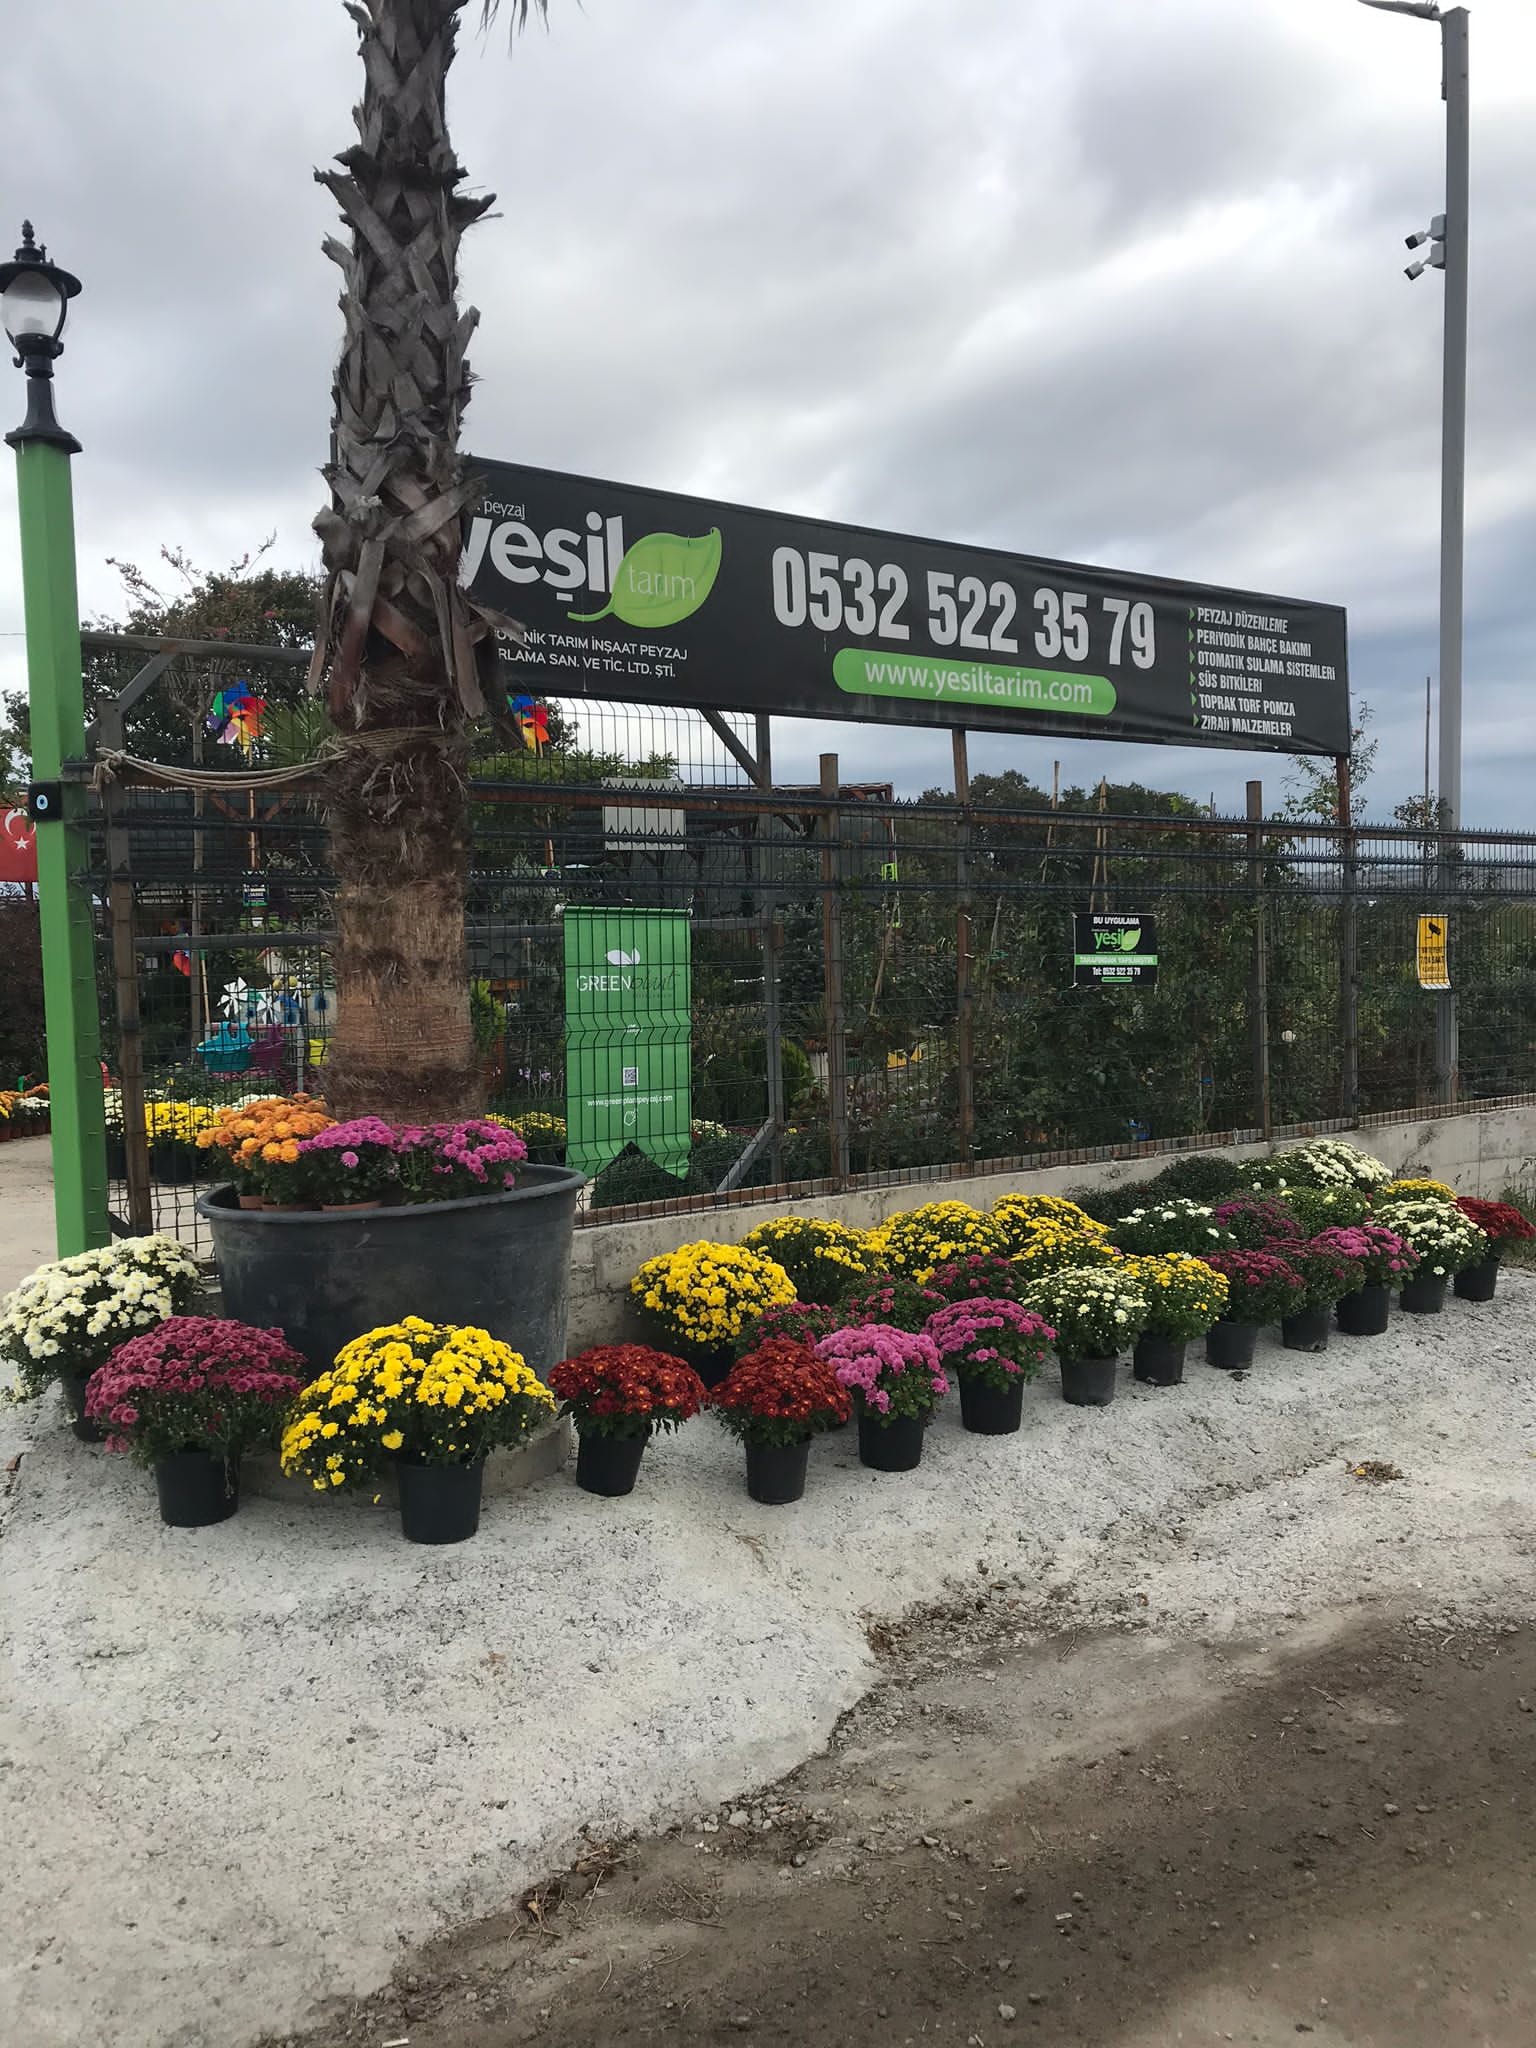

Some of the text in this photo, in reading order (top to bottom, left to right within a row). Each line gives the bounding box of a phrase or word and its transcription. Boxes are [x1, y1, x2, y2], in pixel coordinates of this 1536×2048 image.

[483, 499, 526, 521] peyzaj
[772, 546, 1157, 670] 0532 522 35 79
[1197, 607, 1289, 634] PEYZAJ DÜZENLEME
[548, 634, 589, 649] TARIM
[591, 639, 638, 655] İNŞAAT
[639, 645, 688, 660] PEYZAJ
[1248, 636, 1278, 655] BAHÇE
[1280, 639, 1312, 657] BAKIMI
[549, 653, 580, 668] SAN.
[582, 657, 601, 670] VE
[602, 657, 625, 673] TİC.
[628, 662, 653, 676] LTD.
[655, 662, 677, 679] ŞTİ.
[1247, 656, 1284, 675] SULAMA
[864, 659, 1094, 706] www.yesiltarim.com
[1198, 670, 1218, 689] SÜS
[1199, 693, 1296, 717] TOPRAK TORF POMZA
[1231, 717, 1293, 737] MALZEMELER
[1104, 916, 1140, 925] UYGULAMA
